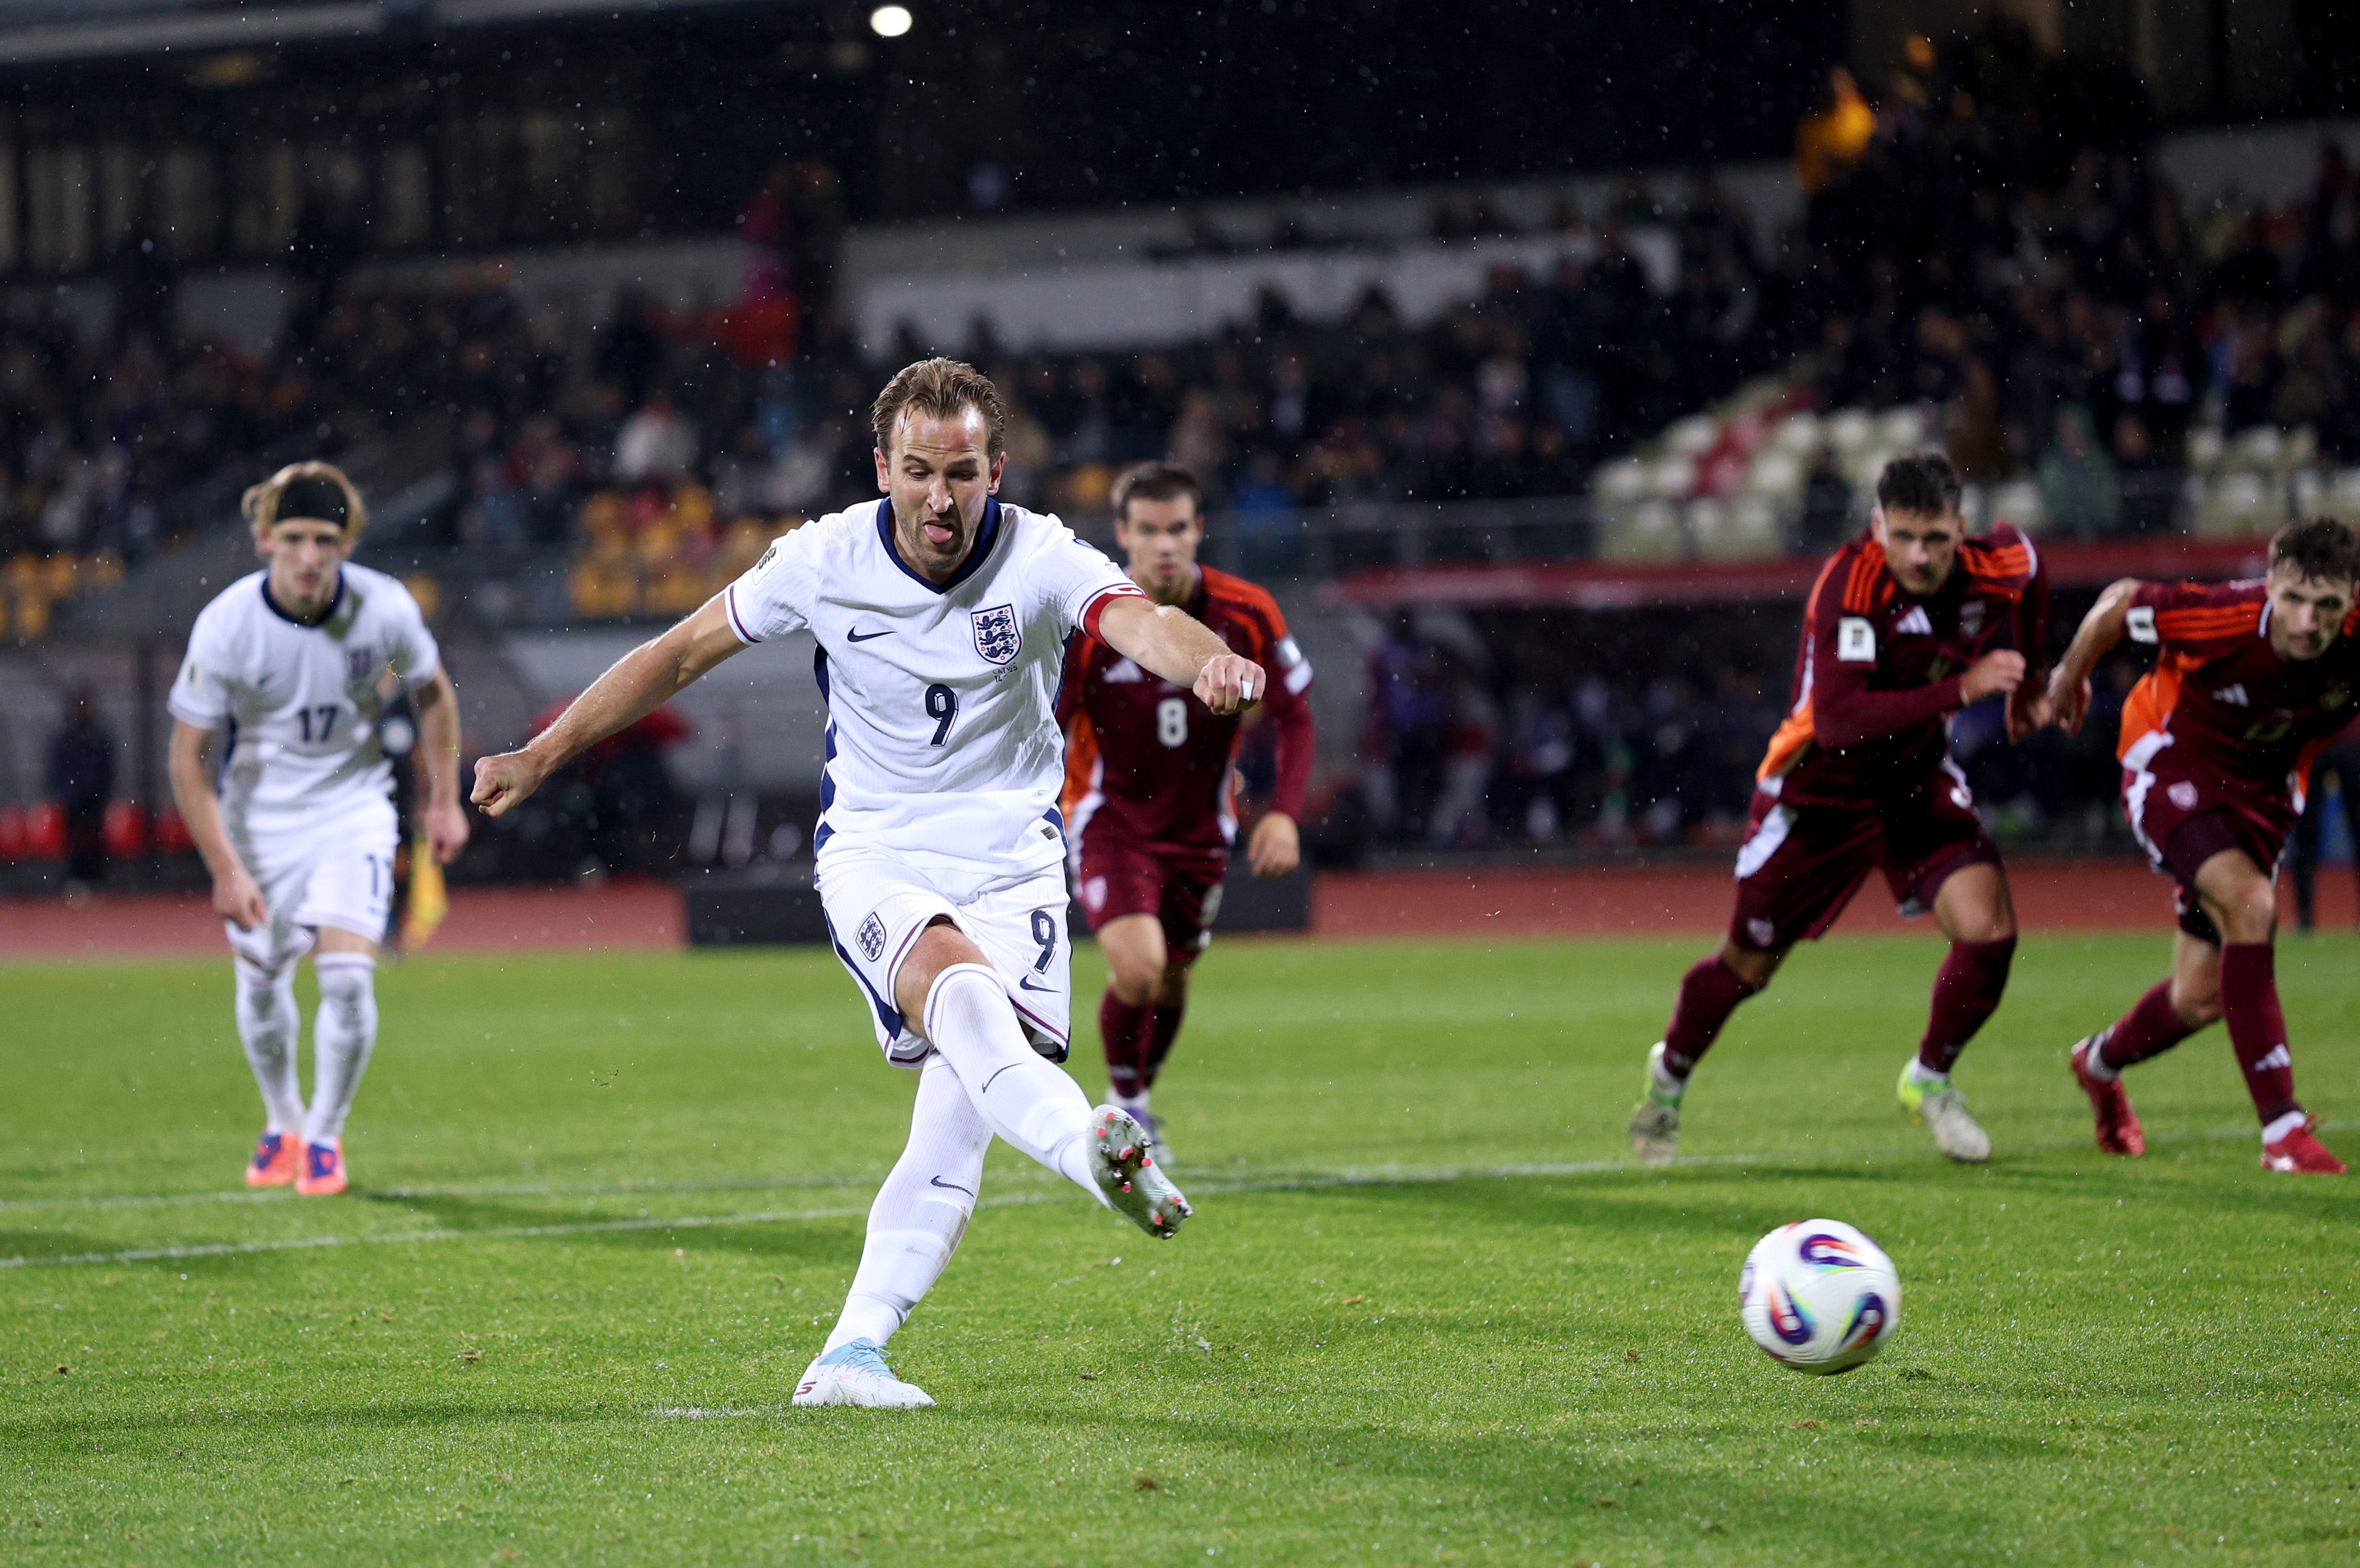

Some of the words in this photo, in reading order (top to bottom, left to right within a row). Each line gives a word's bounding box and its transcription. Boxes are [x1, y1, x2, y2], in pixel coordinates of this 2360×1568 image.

[297, 705, 338, 742] 17
[925, 683, 959, 747] 9
[1157, 697, 1188, 747] 8
[1031, 910, 1058, 974] 9
